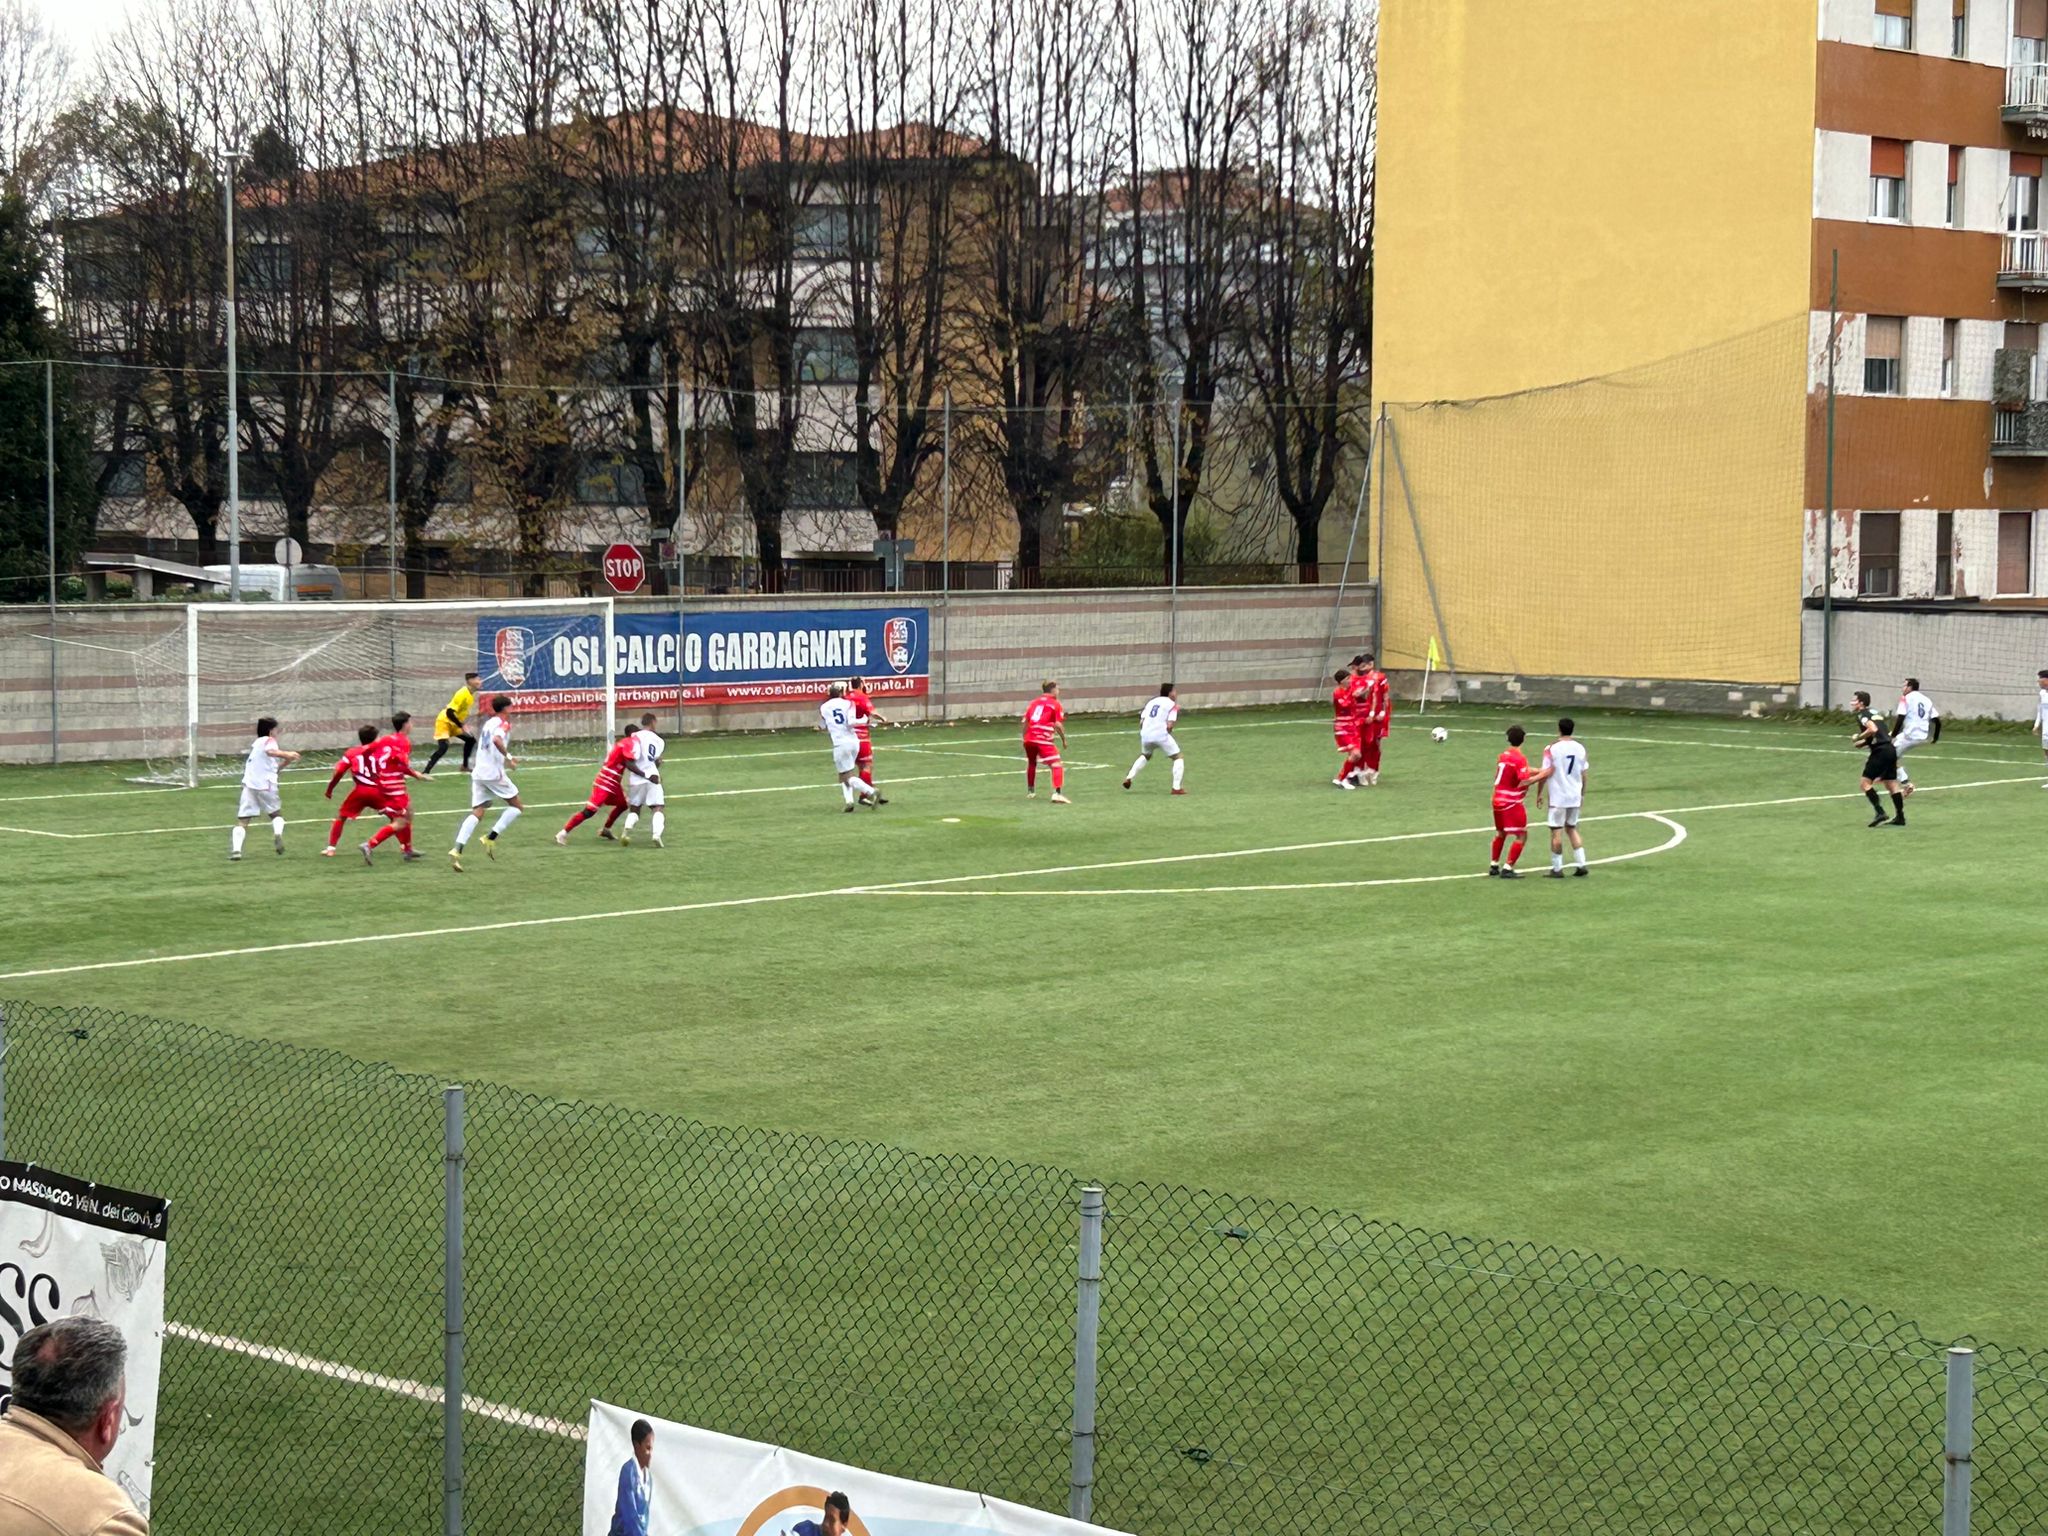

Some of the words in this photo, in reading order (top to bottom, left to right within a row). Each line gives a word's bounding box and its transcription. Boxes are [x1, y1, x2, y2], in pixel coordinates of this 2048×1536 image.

[606, 559, 641, 577] STOP
[554, 636, 603, 676] OSL
[614, 633, 702, 675] CALCIO
[708, 629, 867, 672] GARBAGNATE
[832, 708, 845, 725] 5
[1918, 702, 1926, 719] 6
[647, 743, 657, 762] 9
[1566, 754, 1575, 775] 7
